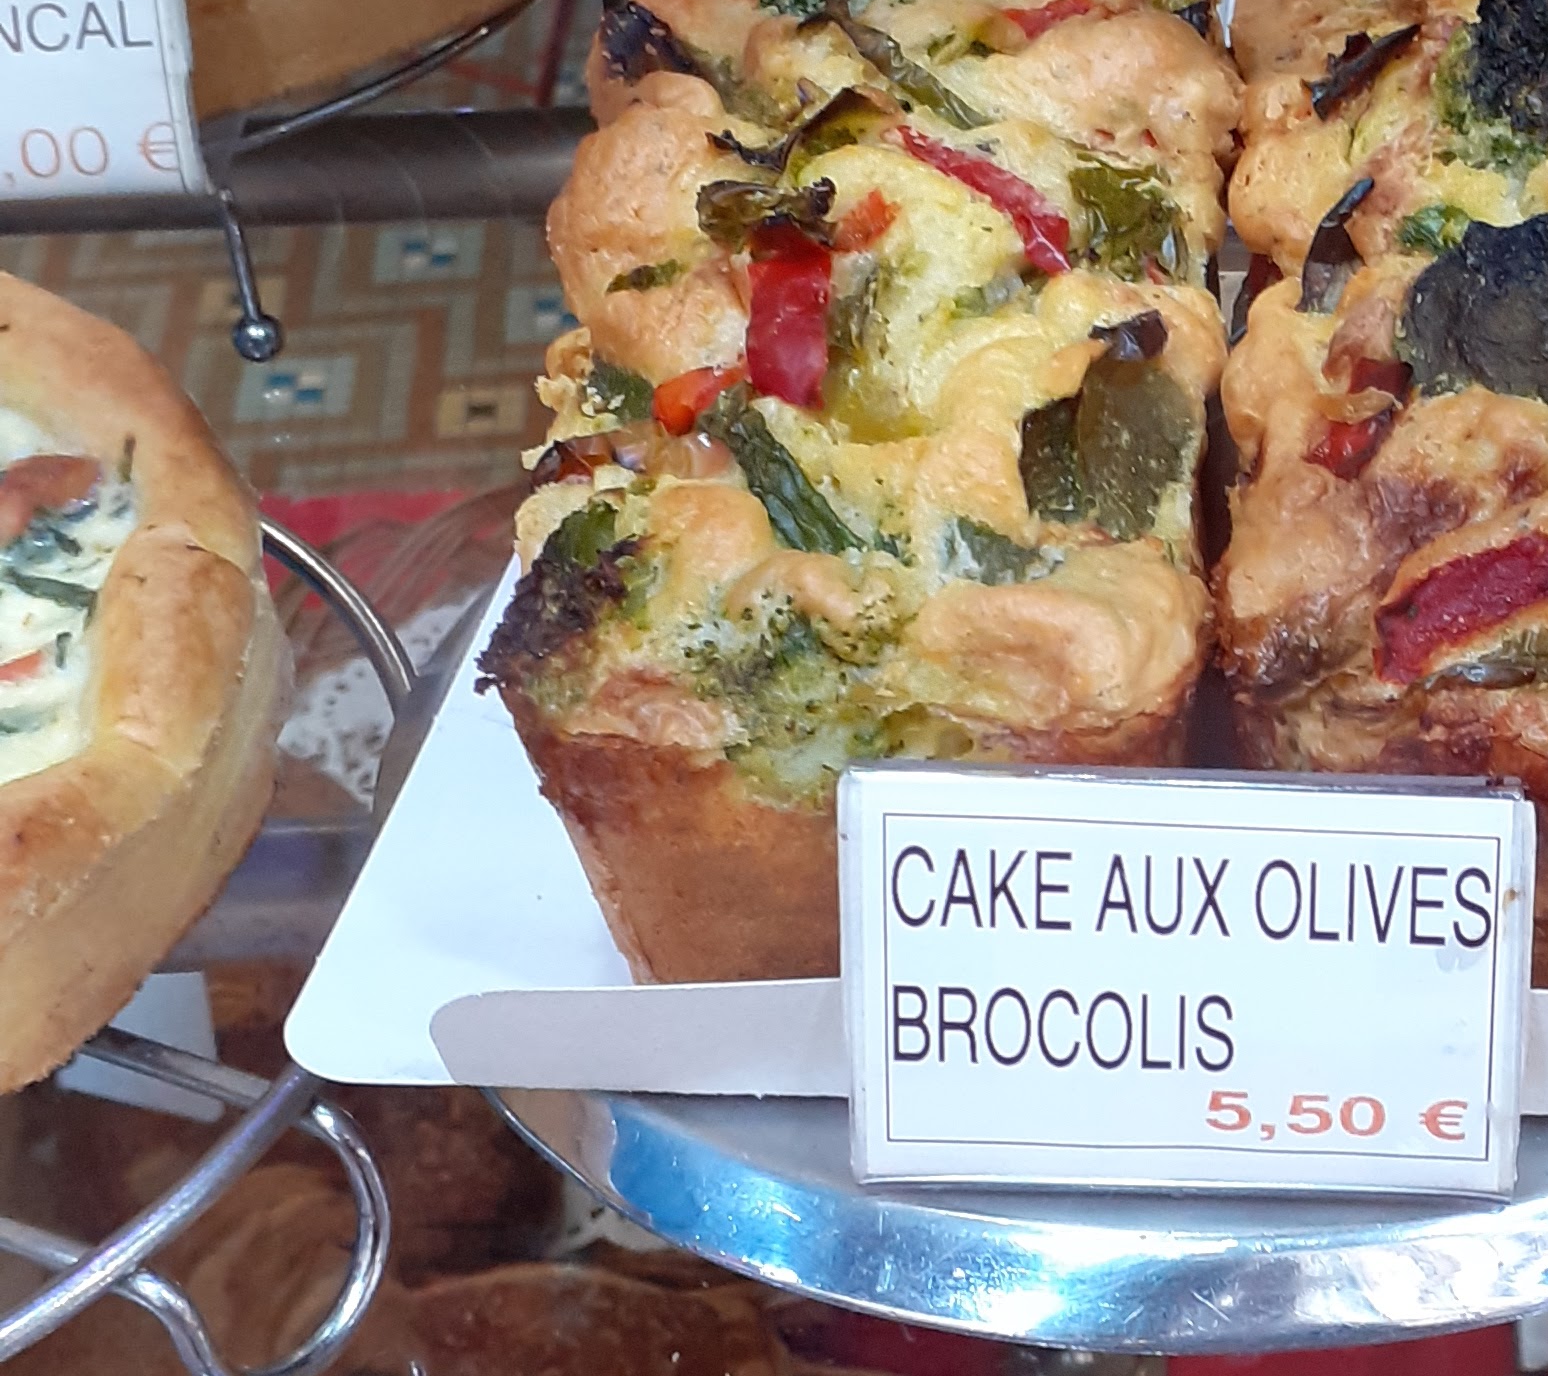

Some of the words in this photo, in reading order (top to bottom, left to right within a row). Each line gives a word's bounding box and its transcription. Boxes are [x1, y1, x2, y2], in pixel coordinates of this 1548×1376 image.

[891, 844, 1073, 932] CAKE
[1095, 854, 1231, 937] AUX
[1254, 859, 1492, 949] OLIVES
[891, 984, 1235, 1073] BROCOLIS
[1204, 1089, 1387, 1141] 5,50
[1417, 1099, 1469, 1141] €
